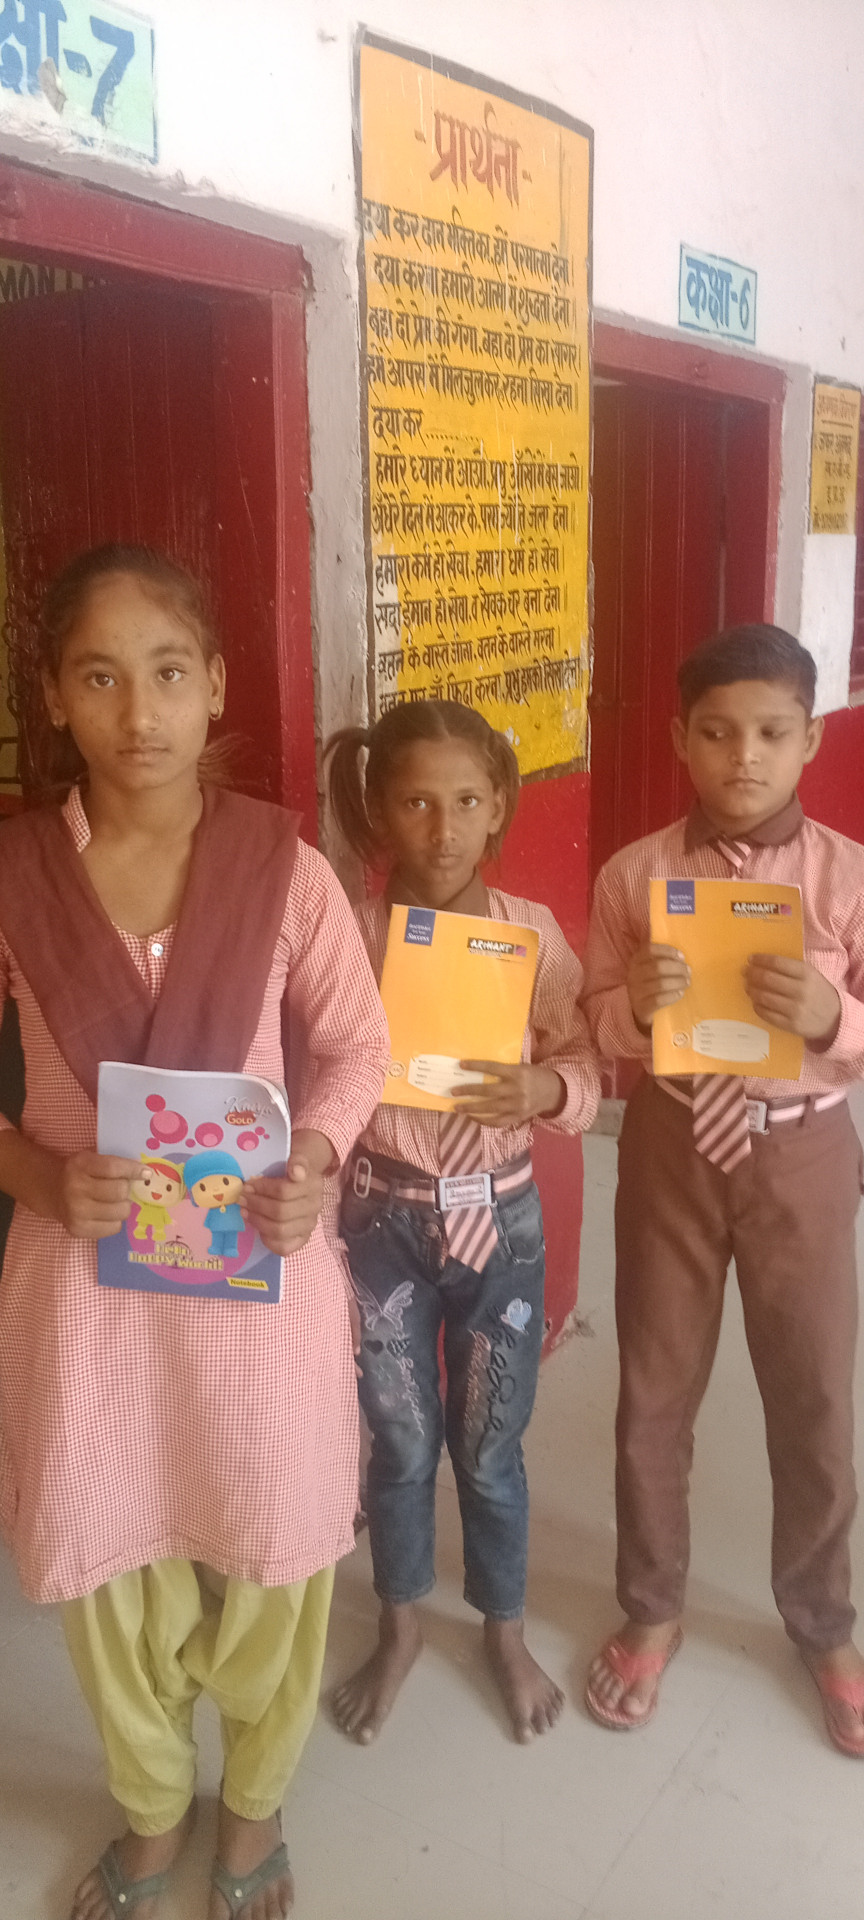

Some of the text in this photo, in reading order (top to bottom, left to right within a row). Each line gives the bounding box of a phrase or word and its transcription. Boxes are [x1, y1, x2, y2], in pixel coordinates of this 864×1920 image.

[430, 100, 523, 207] प्रार्थना
[393, 205, 423, 253] कर
[421, 214, 446, 255] दान
[372, 251, 401, 295] दया
[685, 254, 751, 331] कक्षा-6
[395, 297, 411, 350] दो
[410, 300, 433, 353] प्रेम
[433, 305, 452, 351] की
[482, 328, 503, 371] बहा
[504, 322, 517, 366] दो
[517, 325, 534, 369] प्रेम
[535, 337, 549, 366] का
[386, 356, 426, 400] आपस
[427, 353, 441, 397] में
[553, 372, 573, 415] देना
[371, 405, 400, 447] दया
[401, 406, 427, 448] कर
[374, 444, 411, 497] हमारे
[443, 445, 456, 491] में
[400, 489, 425, 543] दिल
[424, 493, 437, 539] में
[435, 503, 470, 539] आकर
[551, 494, 570, 538] देना
[375, 552, 413, 597] हमारा
[411, 541, 434, 584] कर्म
[432, 539, 447, 598] हो
[527, 535, 539, 583] हो
[540, 537, 560, 576] सेवा
[374, 601, 402, 636] सदा
[402, 589, 433, 642] ईमान
[435, 587, 451, 640] हो
[522, 586, 543, 618] बना
[543, 578, 561, 617] देना
[406, 637, 420, 674] के
[496, 625, 508, 660] के
[230, 1279, 265, 1289] Notebook
